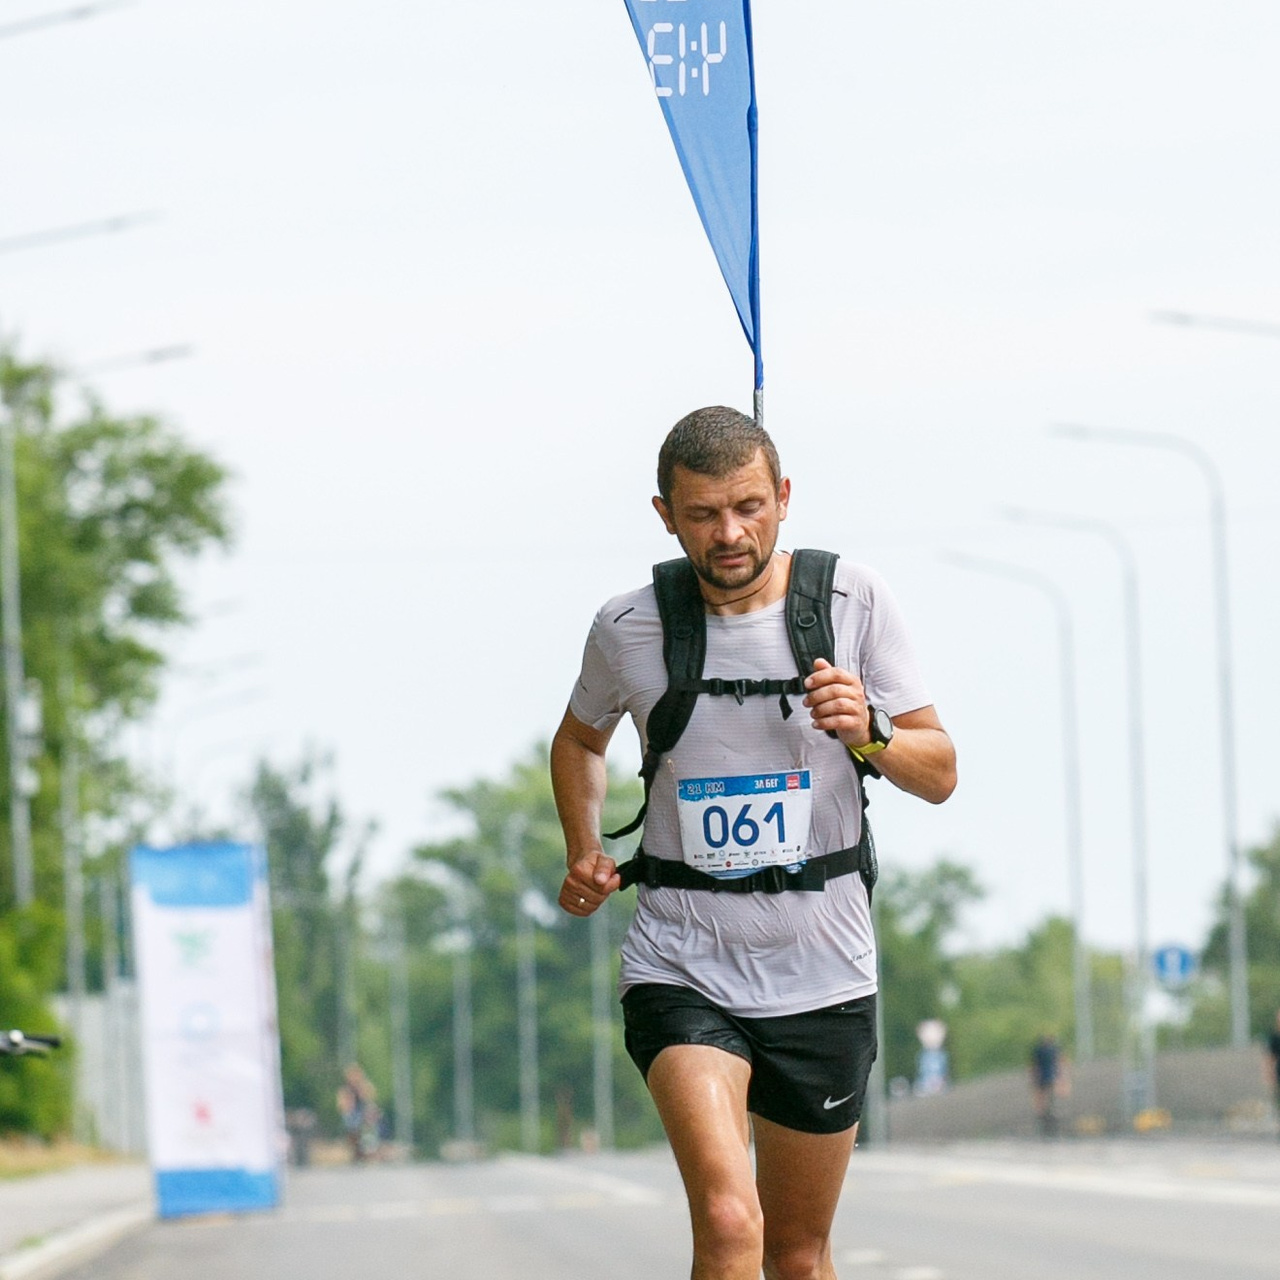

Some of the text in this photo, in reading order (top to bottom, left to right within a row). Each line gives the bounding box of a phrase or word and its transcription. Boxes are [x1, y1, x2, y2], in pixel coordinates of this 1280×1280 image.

[754, 780, 765, 789] ЗА
[765, 778, 779, 788] БЕГ
[687, 784, 702, 795] 21
[702, 802, 786, 849] 061
